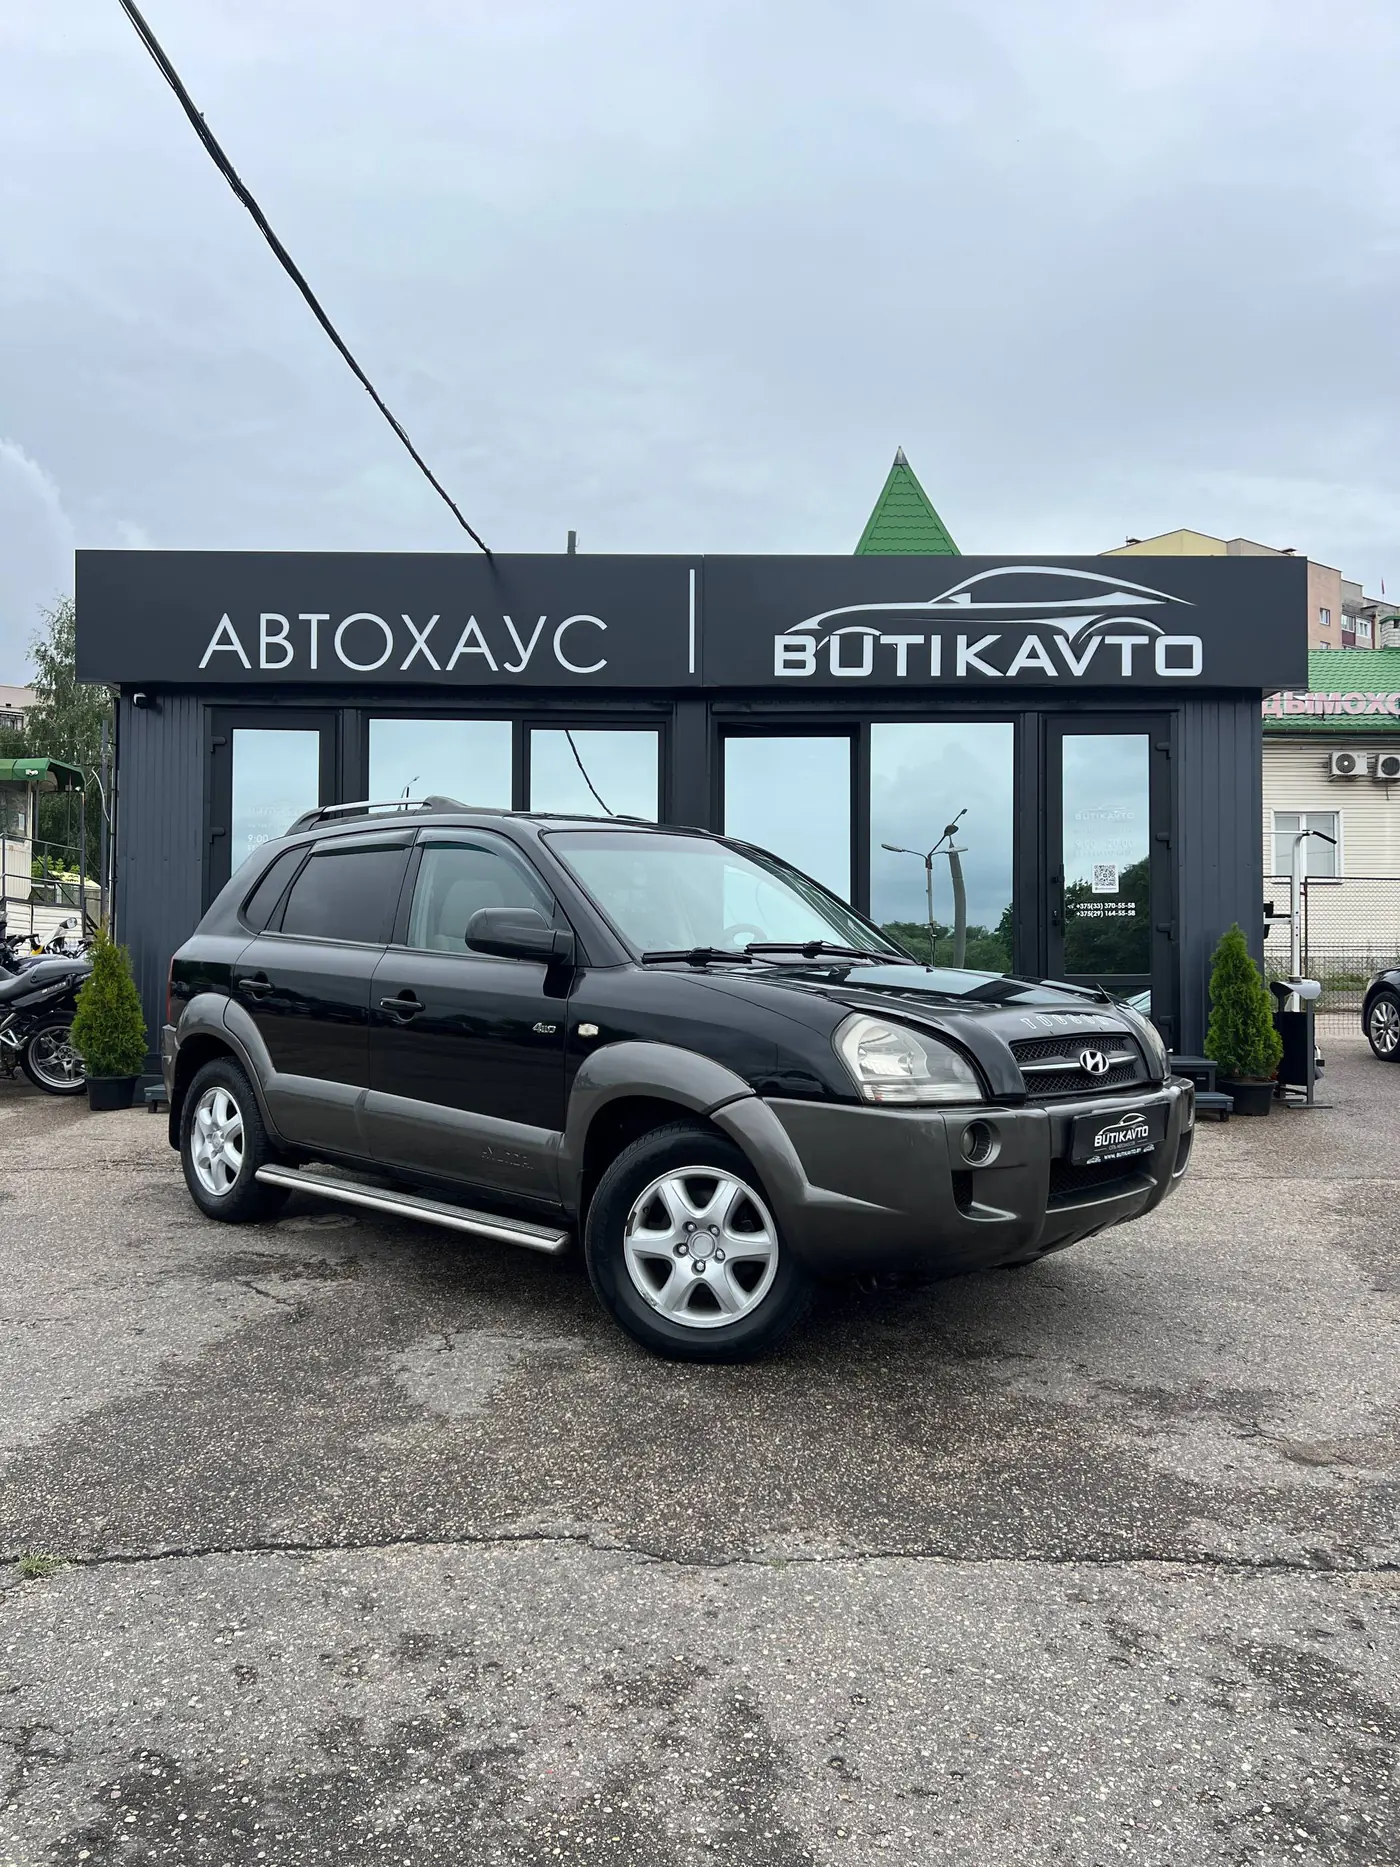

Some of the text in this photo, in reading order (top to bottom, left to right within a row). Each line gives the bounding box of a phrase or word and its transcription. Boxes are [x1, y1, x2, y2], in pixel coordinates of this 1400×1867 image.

[198, 612, 608, 674] АВТОХАУС
[773, 634, 1203, 677] BUTIKAVTO
[1076, 902, 1104, 910] +375(33)
[1094, 1125, 1149, 1147] BUTIKAVTO
